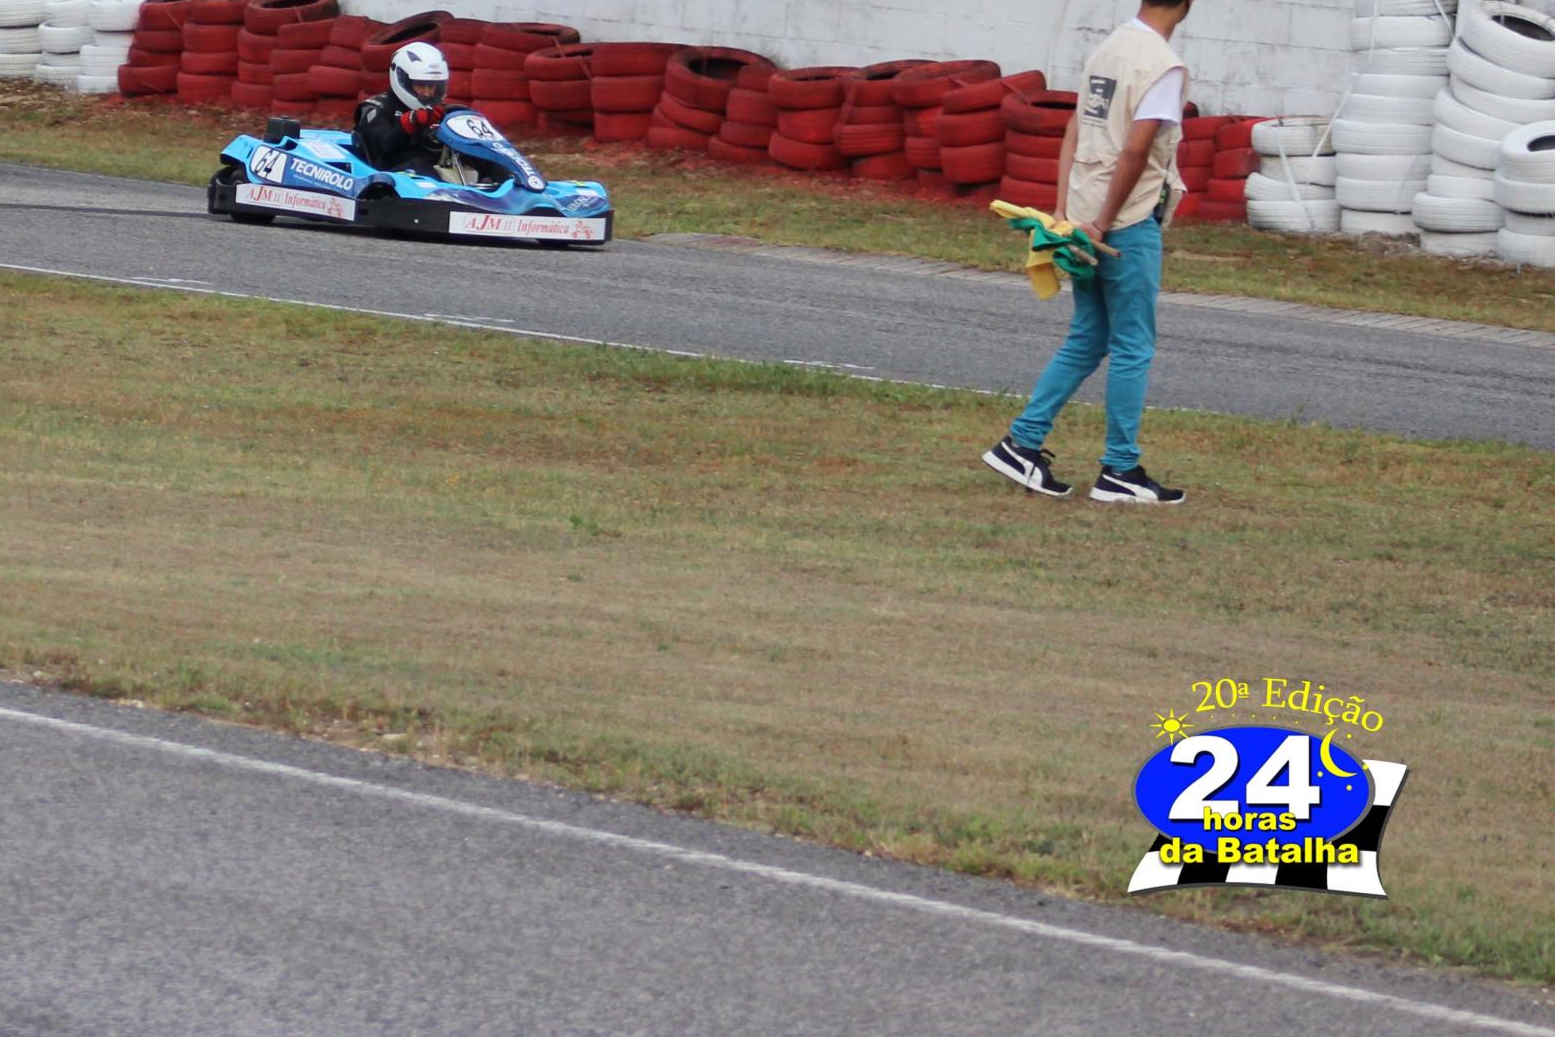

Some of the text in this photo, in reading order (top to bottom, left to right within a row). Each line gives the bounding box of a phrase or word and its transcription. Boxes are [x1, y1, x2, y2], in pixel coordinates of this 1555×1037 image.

[466, 119, 494, 138] 64
[254, 149, 281, 179] 64
[290, 157, 354, 192] TECNIROLO
[466, 215, 501, 231] AJM
[517, 219, 570, 238] Informática
